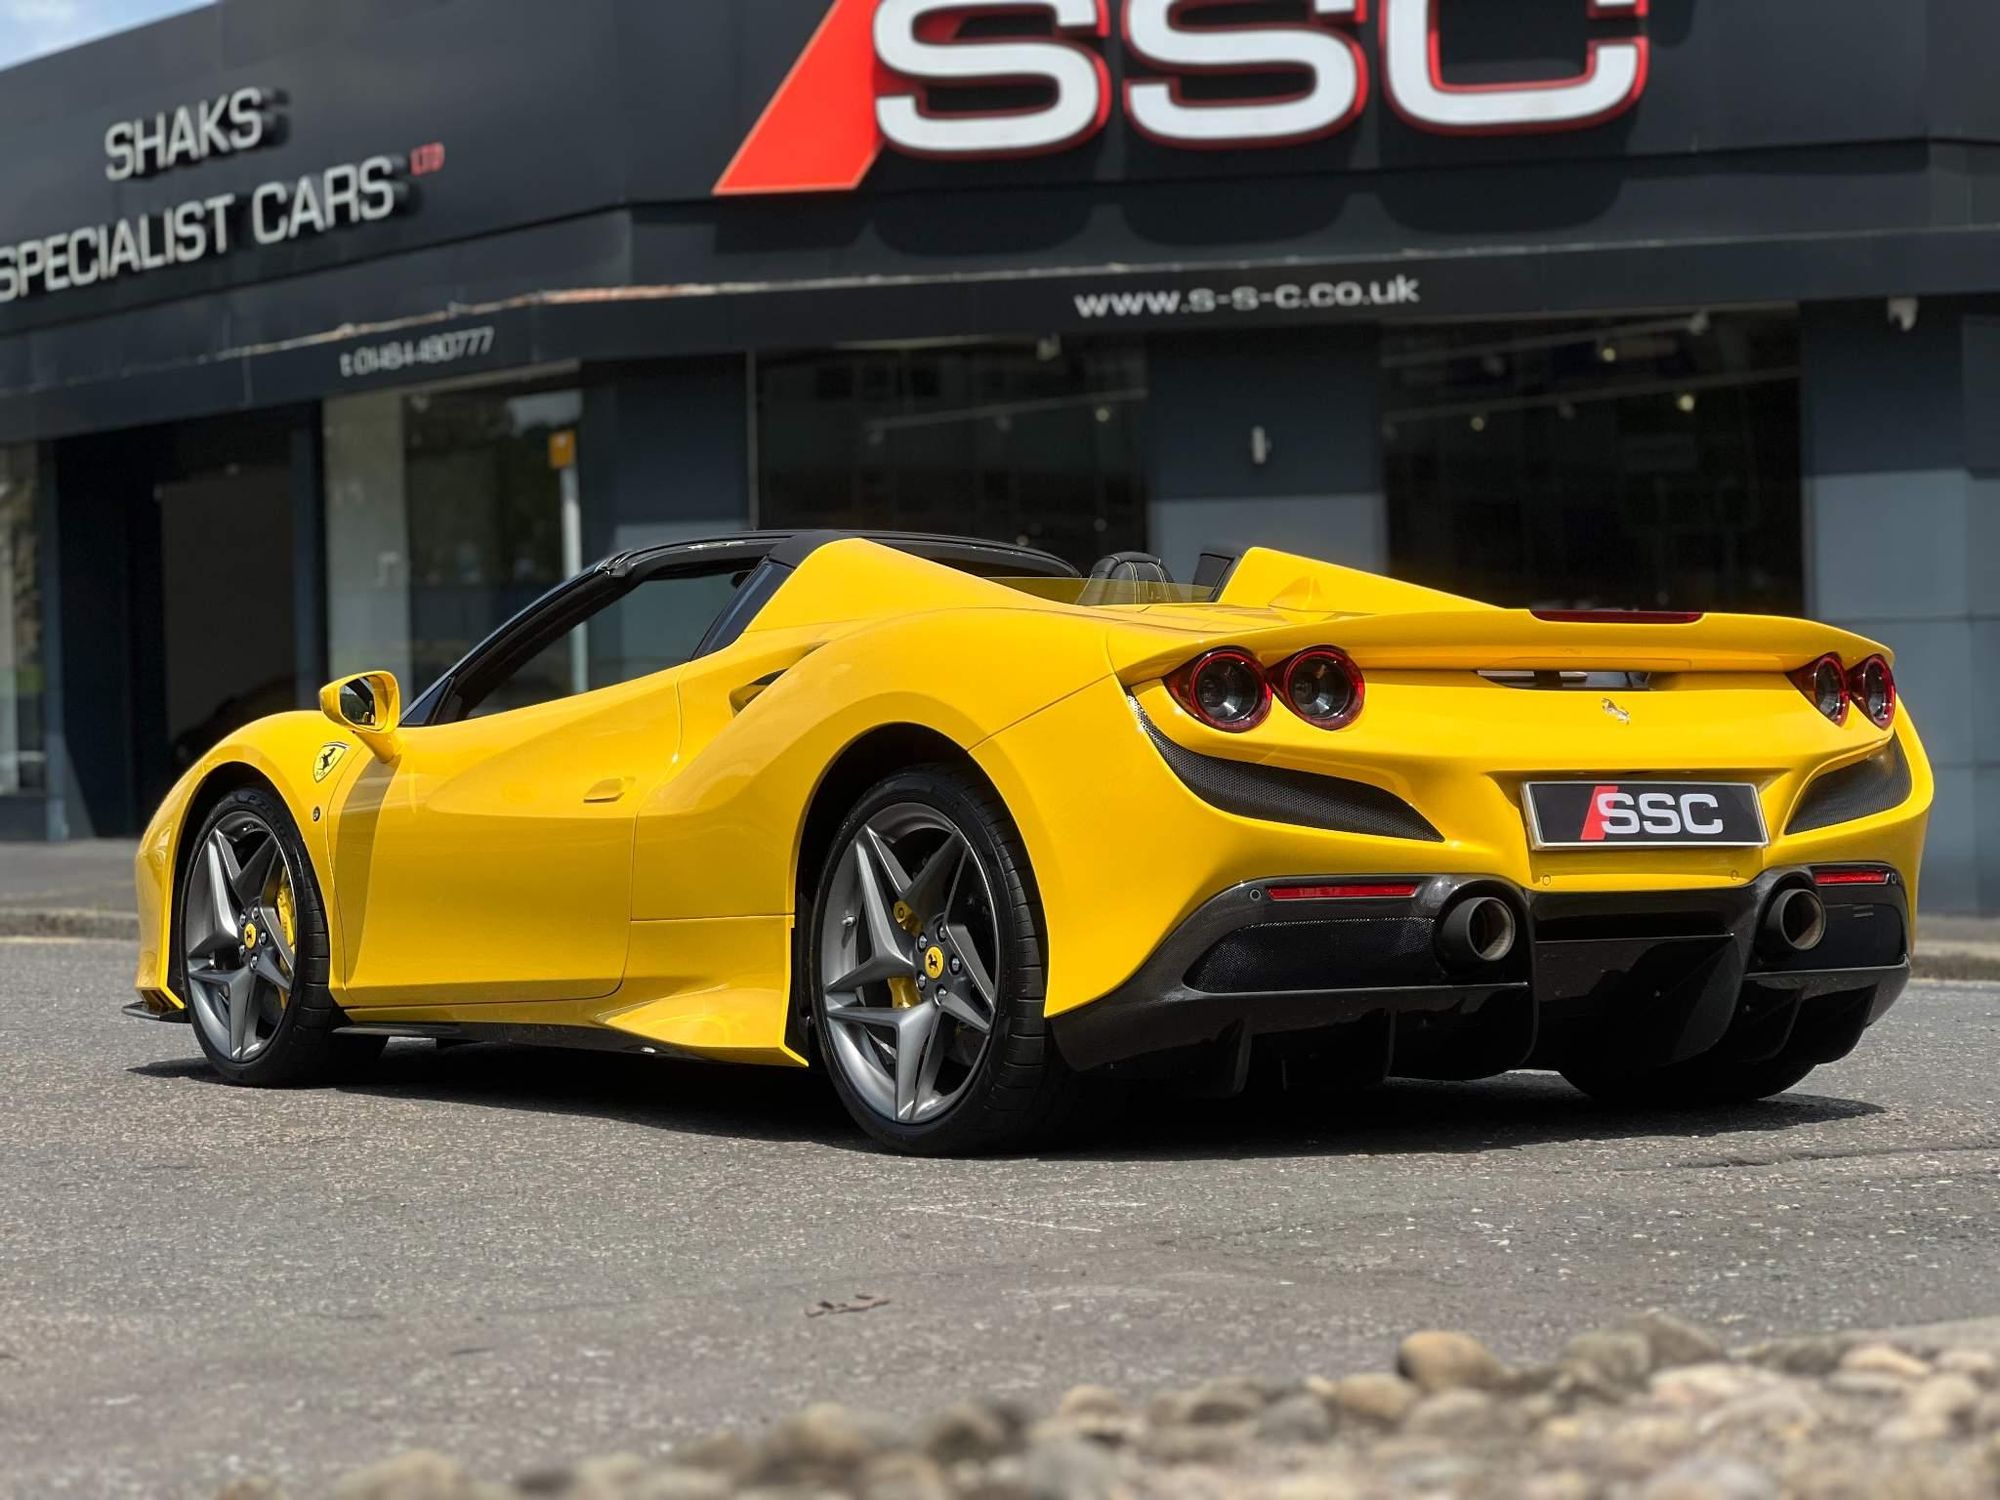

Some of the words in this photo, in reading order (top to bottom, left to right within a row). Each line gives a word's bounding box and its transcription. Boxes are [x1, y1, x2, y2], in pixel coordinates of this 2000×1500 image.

[873, 0, 1648, 156] SSC
[105, 87, 263, 181] SHAKS
[0, 193, 236, 302] SPECIALIST
[252, 156, 395, 244] CARS
[410, 142, 445, 177] LTD
[1073, 273, 1421, 318] www.s-s-c.co.uk
[1597, 793, 1724, 835] SSC
